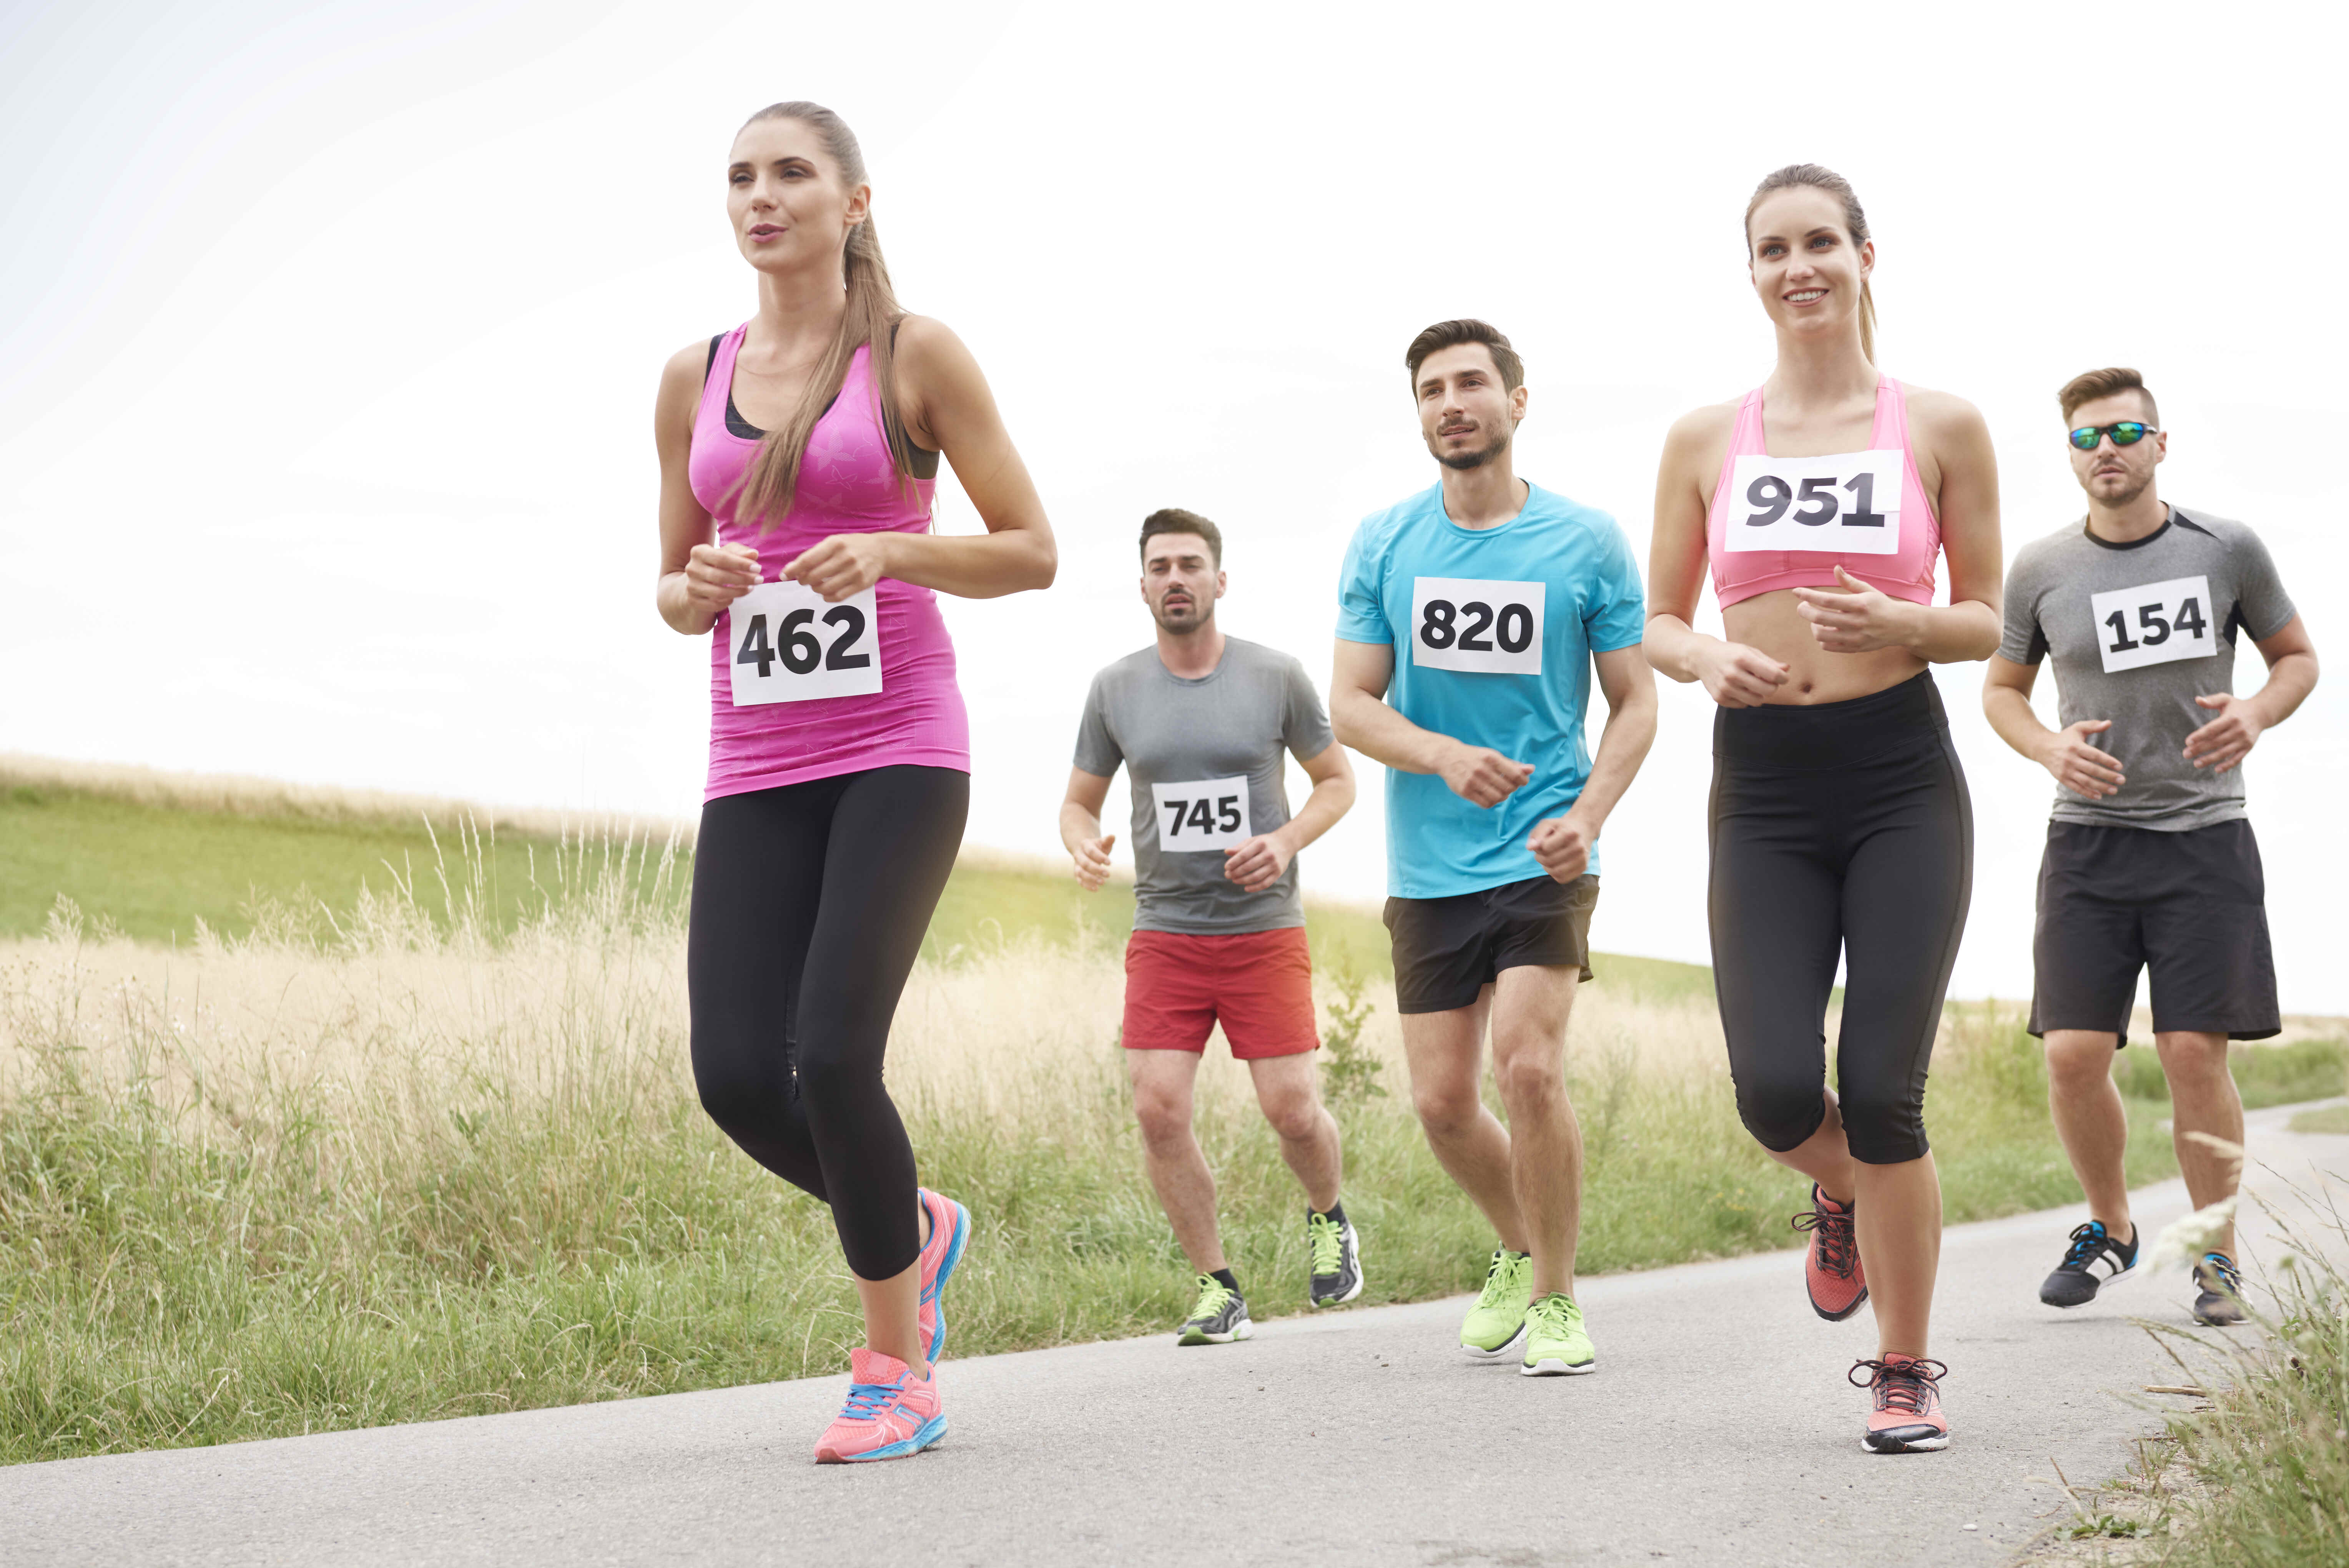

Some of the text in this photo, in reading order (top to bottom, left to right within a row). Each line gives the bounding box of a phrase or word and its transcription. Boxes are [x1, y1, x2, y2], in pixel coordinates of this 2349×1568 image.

[1746, 473, 1885, 527] 951
[737, 605, 871, 678] 462
[1420, 599, 1534, 653] 820
[2105, 597, 2206, 653] 154
[1164, 795, 1241, 836] 745
